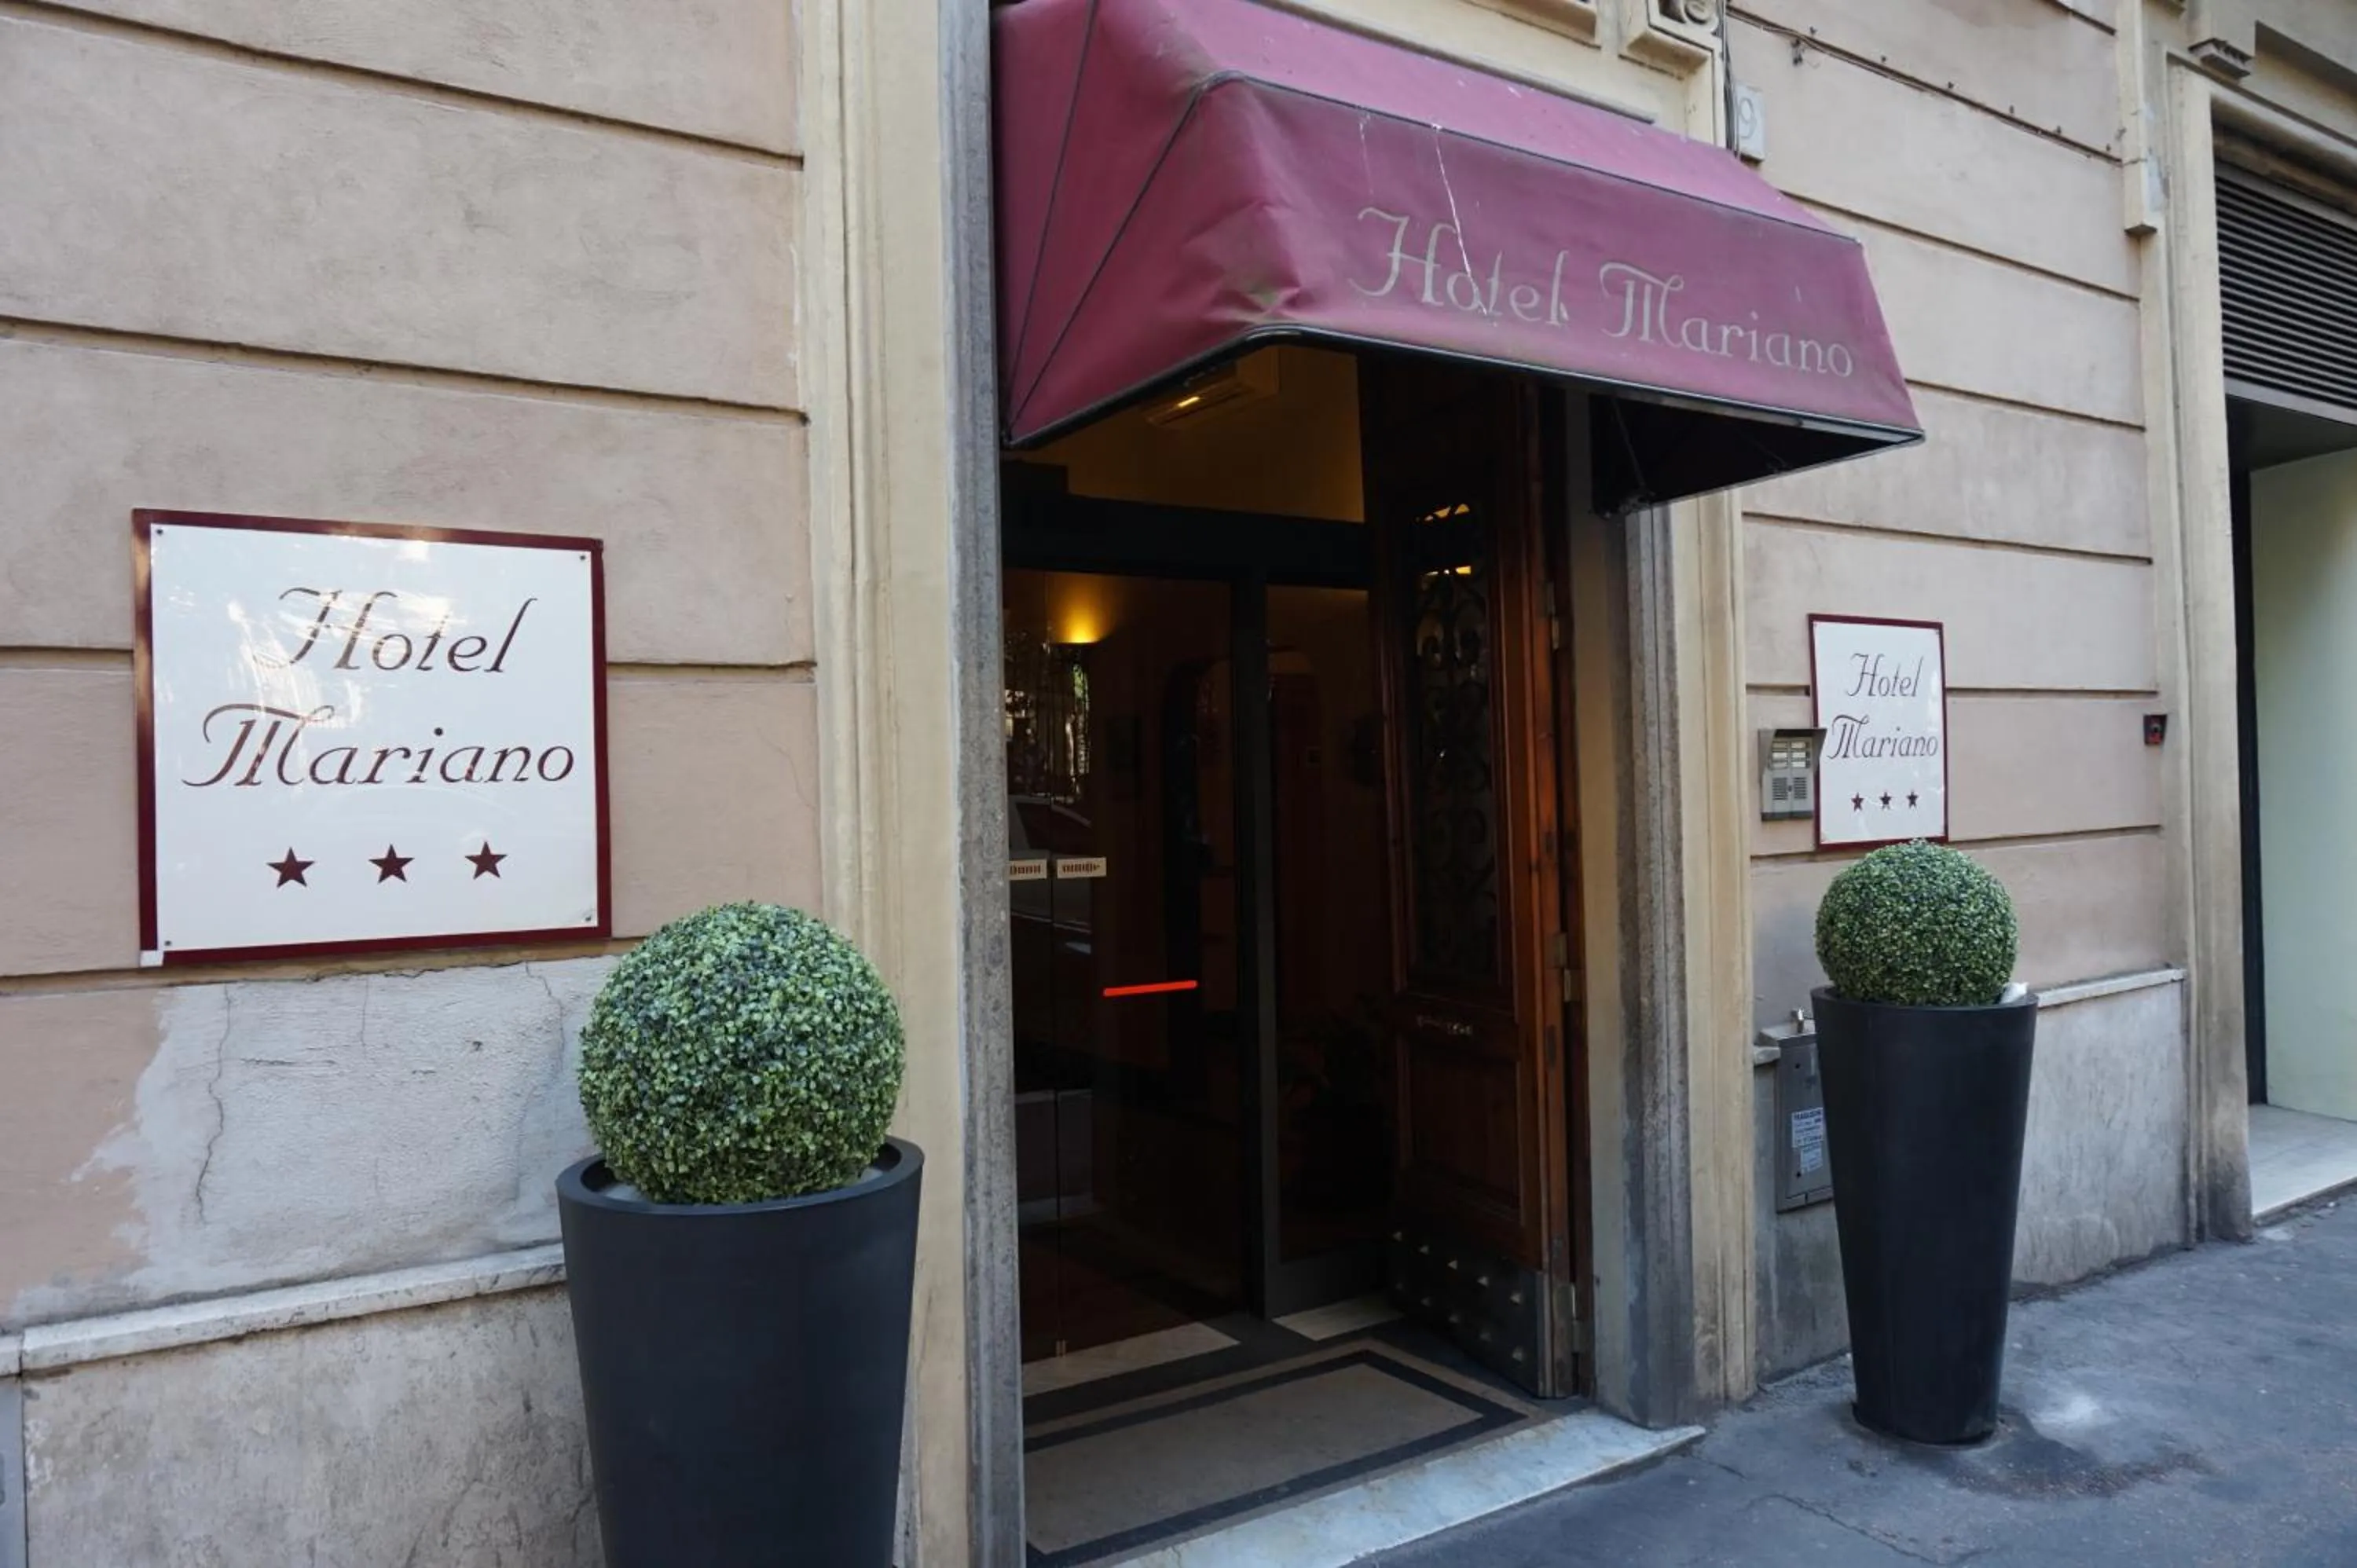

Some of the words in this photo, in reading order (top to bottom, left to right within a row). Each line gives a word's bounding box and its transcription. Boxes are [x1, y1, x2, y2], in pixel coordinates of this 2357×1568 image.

[1348, 207, 1569, 326] Hotel
[1599, 261, 1853, 377] Mariano
[252, 587, 538, 673] Hotel
[1845, 653, 1924, 697] Hotel
[181, 703, 574, 786] Mariano
[1827, 714, 1938, 759] Mariano
